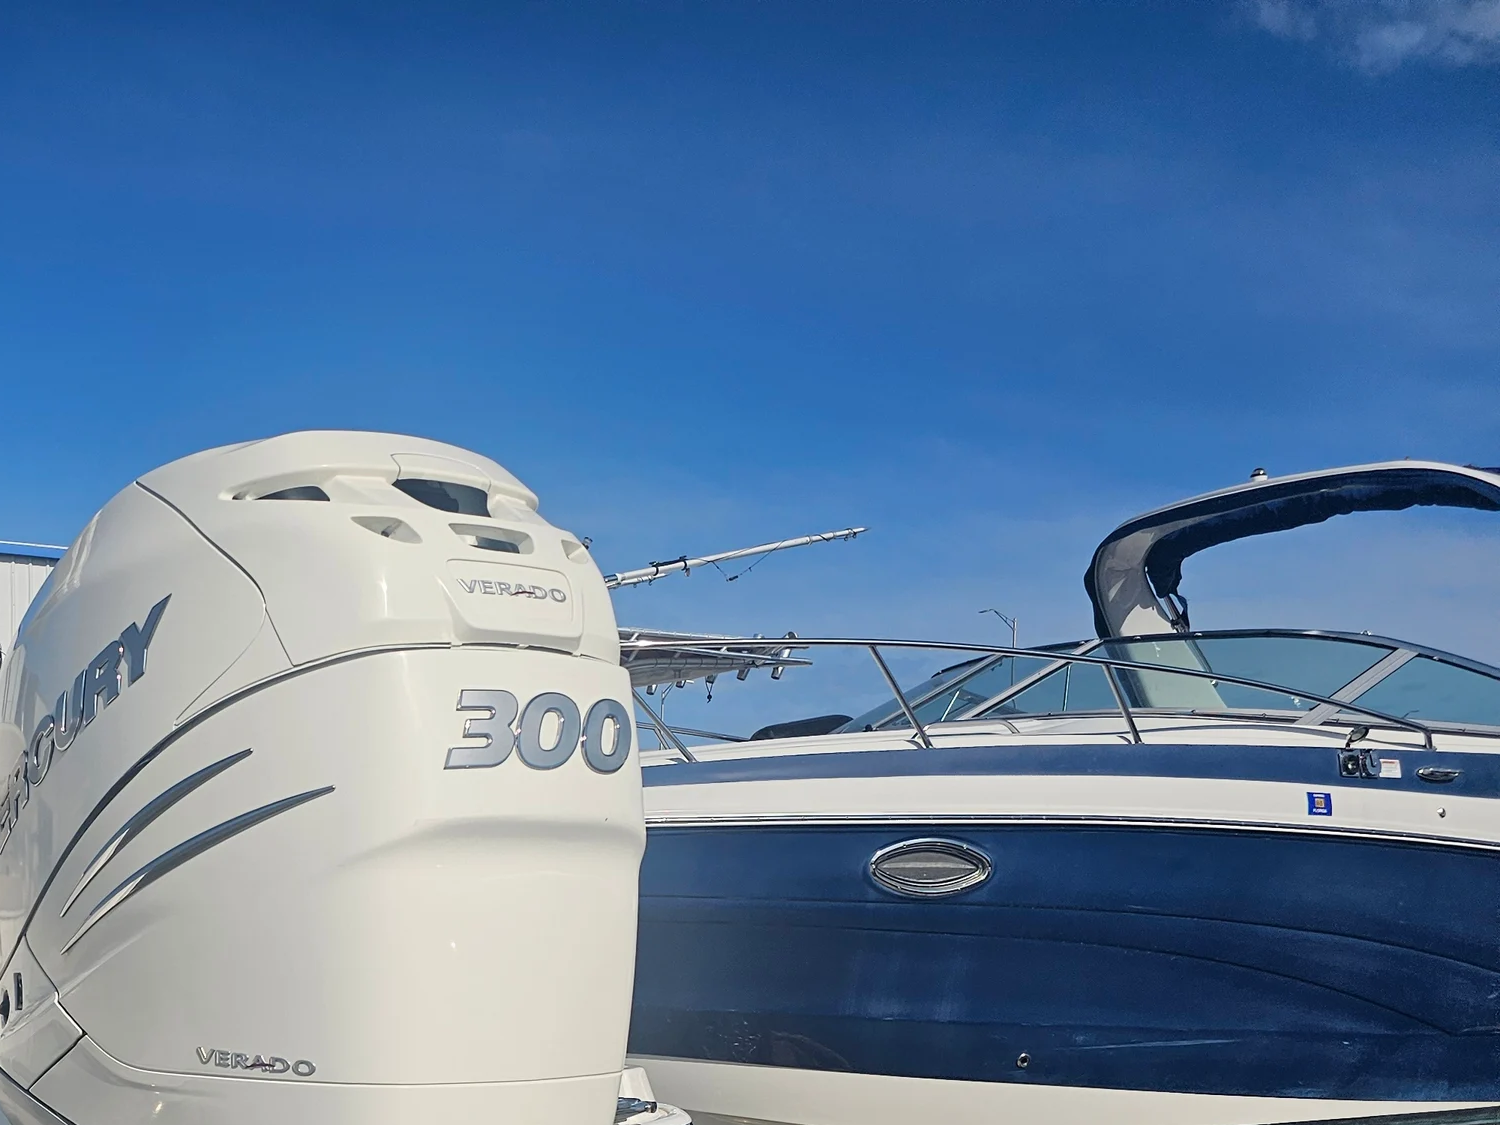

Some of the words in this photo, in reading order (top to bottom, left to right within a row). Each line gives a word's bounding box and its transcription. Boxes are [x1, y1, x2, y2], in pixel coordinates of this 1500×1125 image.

[456, 578, 567, 603] VERADO
[443, 688, 632, 775] 300
[196, 1046, 316, 1077] VERADO
